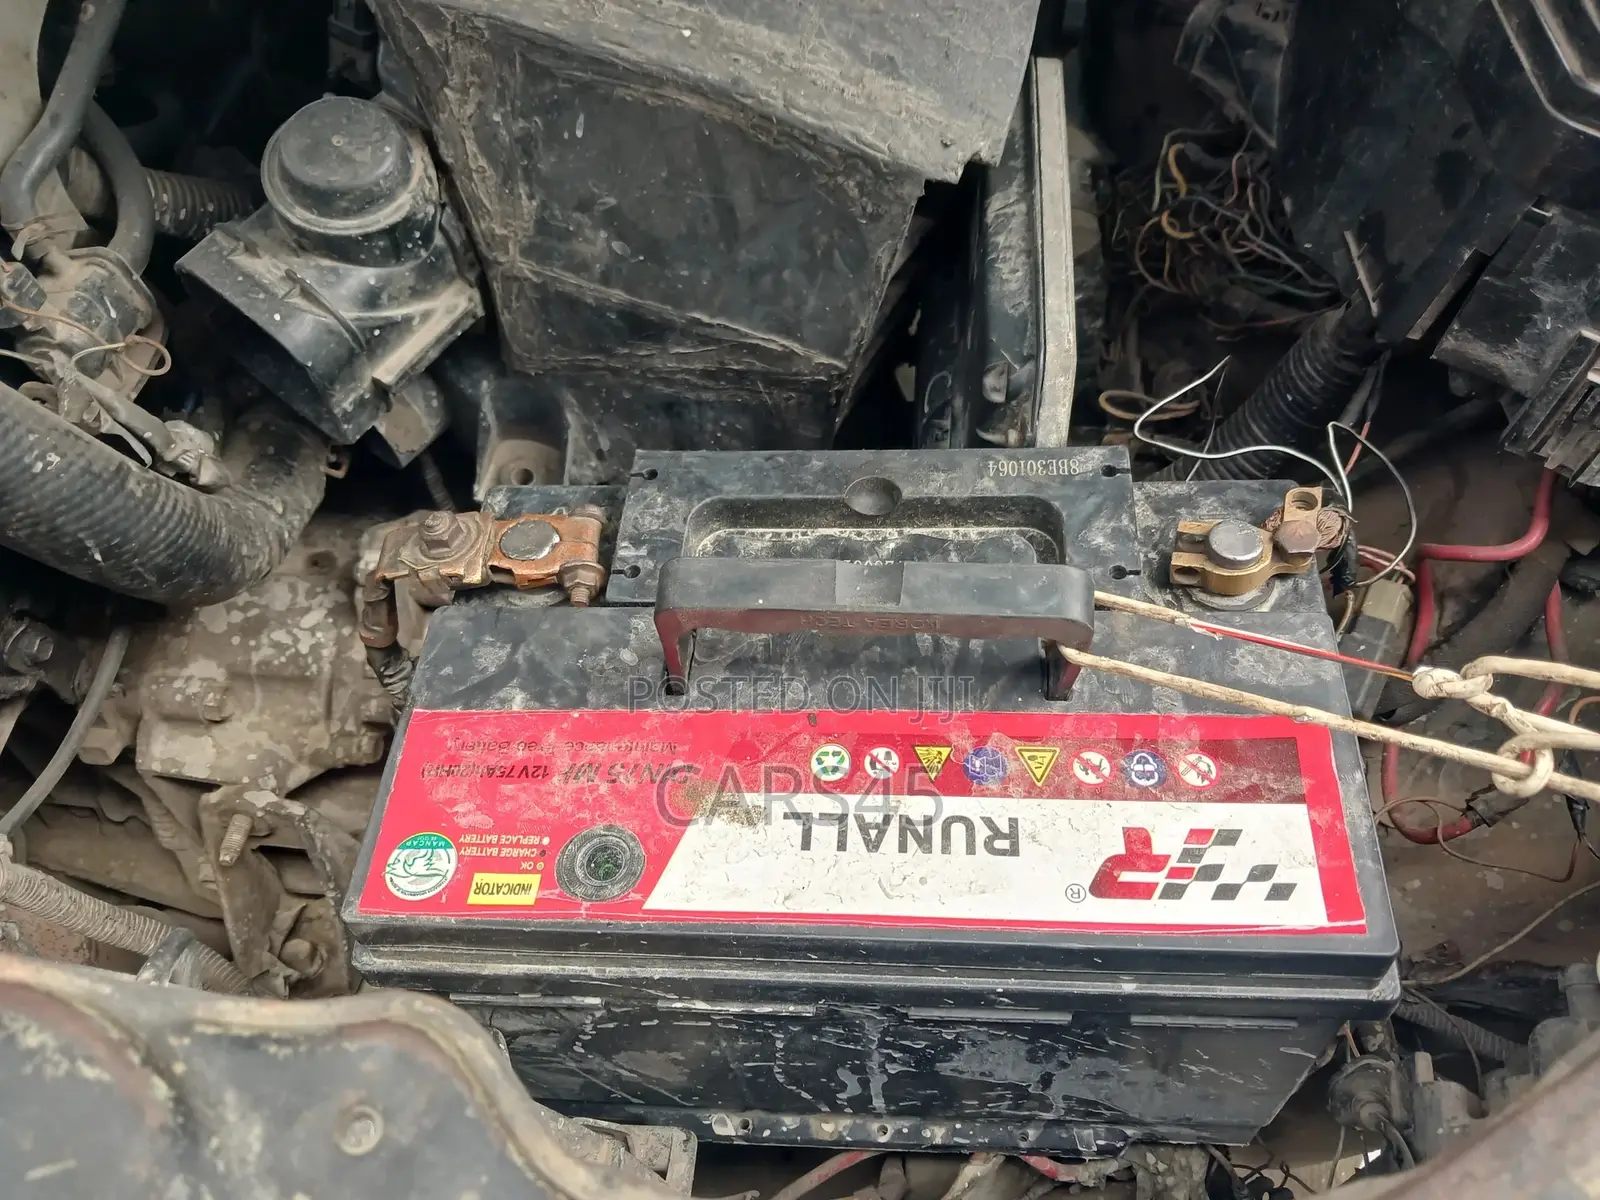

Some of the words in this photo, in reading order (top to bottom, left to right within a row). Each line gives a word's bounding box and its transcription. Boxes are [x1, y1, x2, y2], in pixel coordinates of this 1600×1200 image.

[987, 458, 1079, 477] 8BE301064
[459, 833, 498, 845] BATTERY
[499, 834, 541, 846] REPLACE
[783, 811, 1020, 857] RUNALL
[459, 846, 498, 857] BATTERY
[499, 847, 537, 858] CHARGE
[520, 861, 534, 870] OK
[473, 881, 533, 897] INDICATOR
